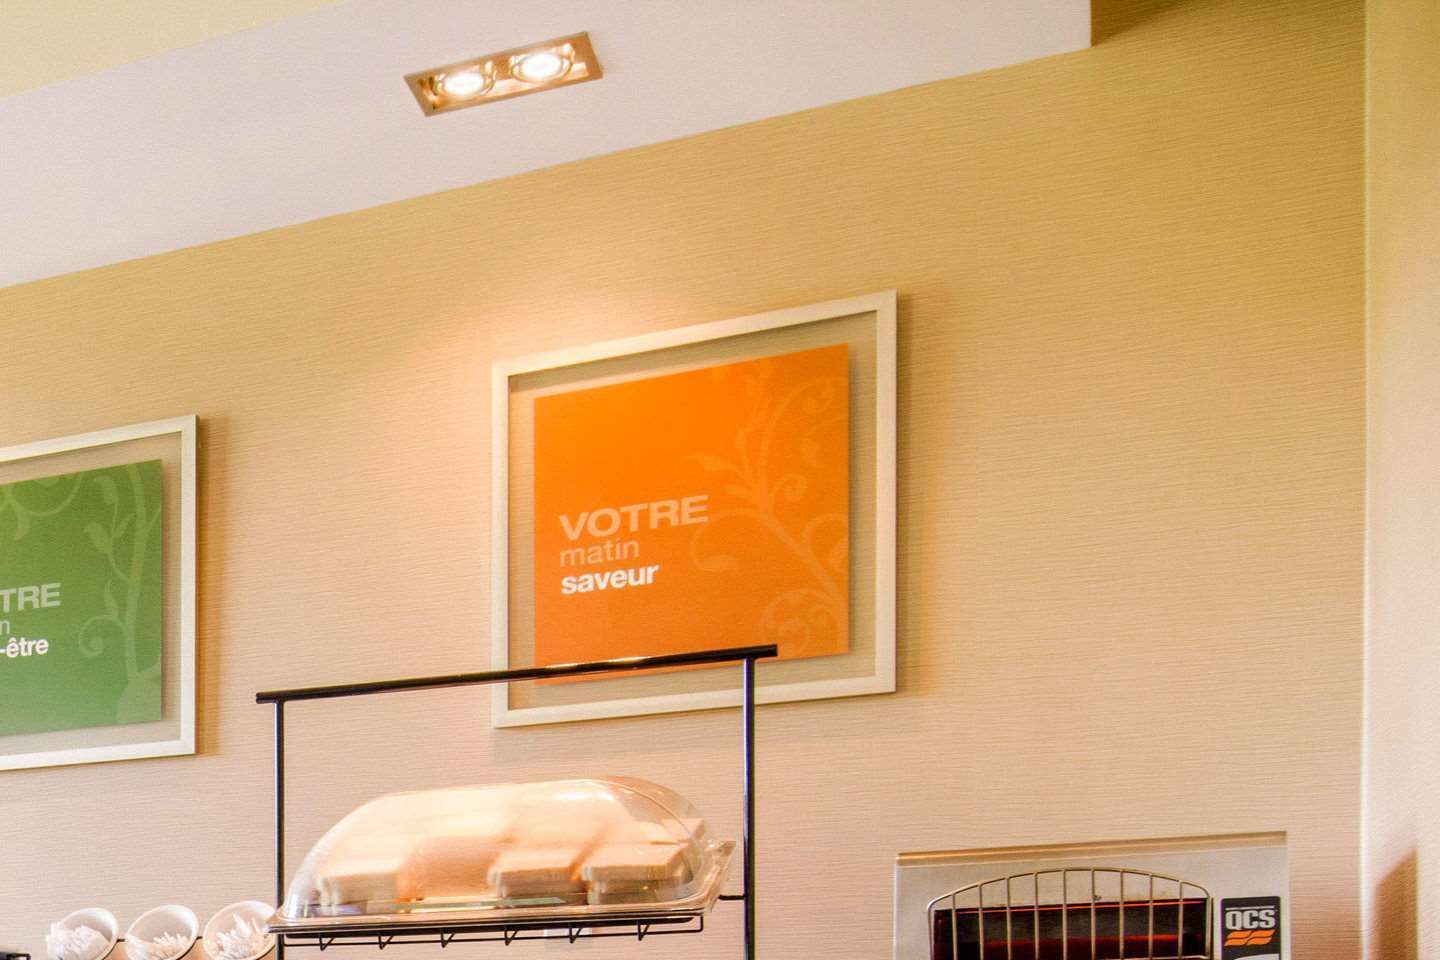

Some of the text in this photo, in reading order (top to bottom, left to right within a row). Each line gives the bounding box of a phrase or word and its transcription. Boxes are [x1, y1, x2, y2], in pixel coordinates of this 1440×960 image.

[559, 495, 709, 541] VOTRE
[559, 538, 641, 568] matin
[561, 565, 659, 596] saveur
[1225, 909, 1276, 931] QCS
